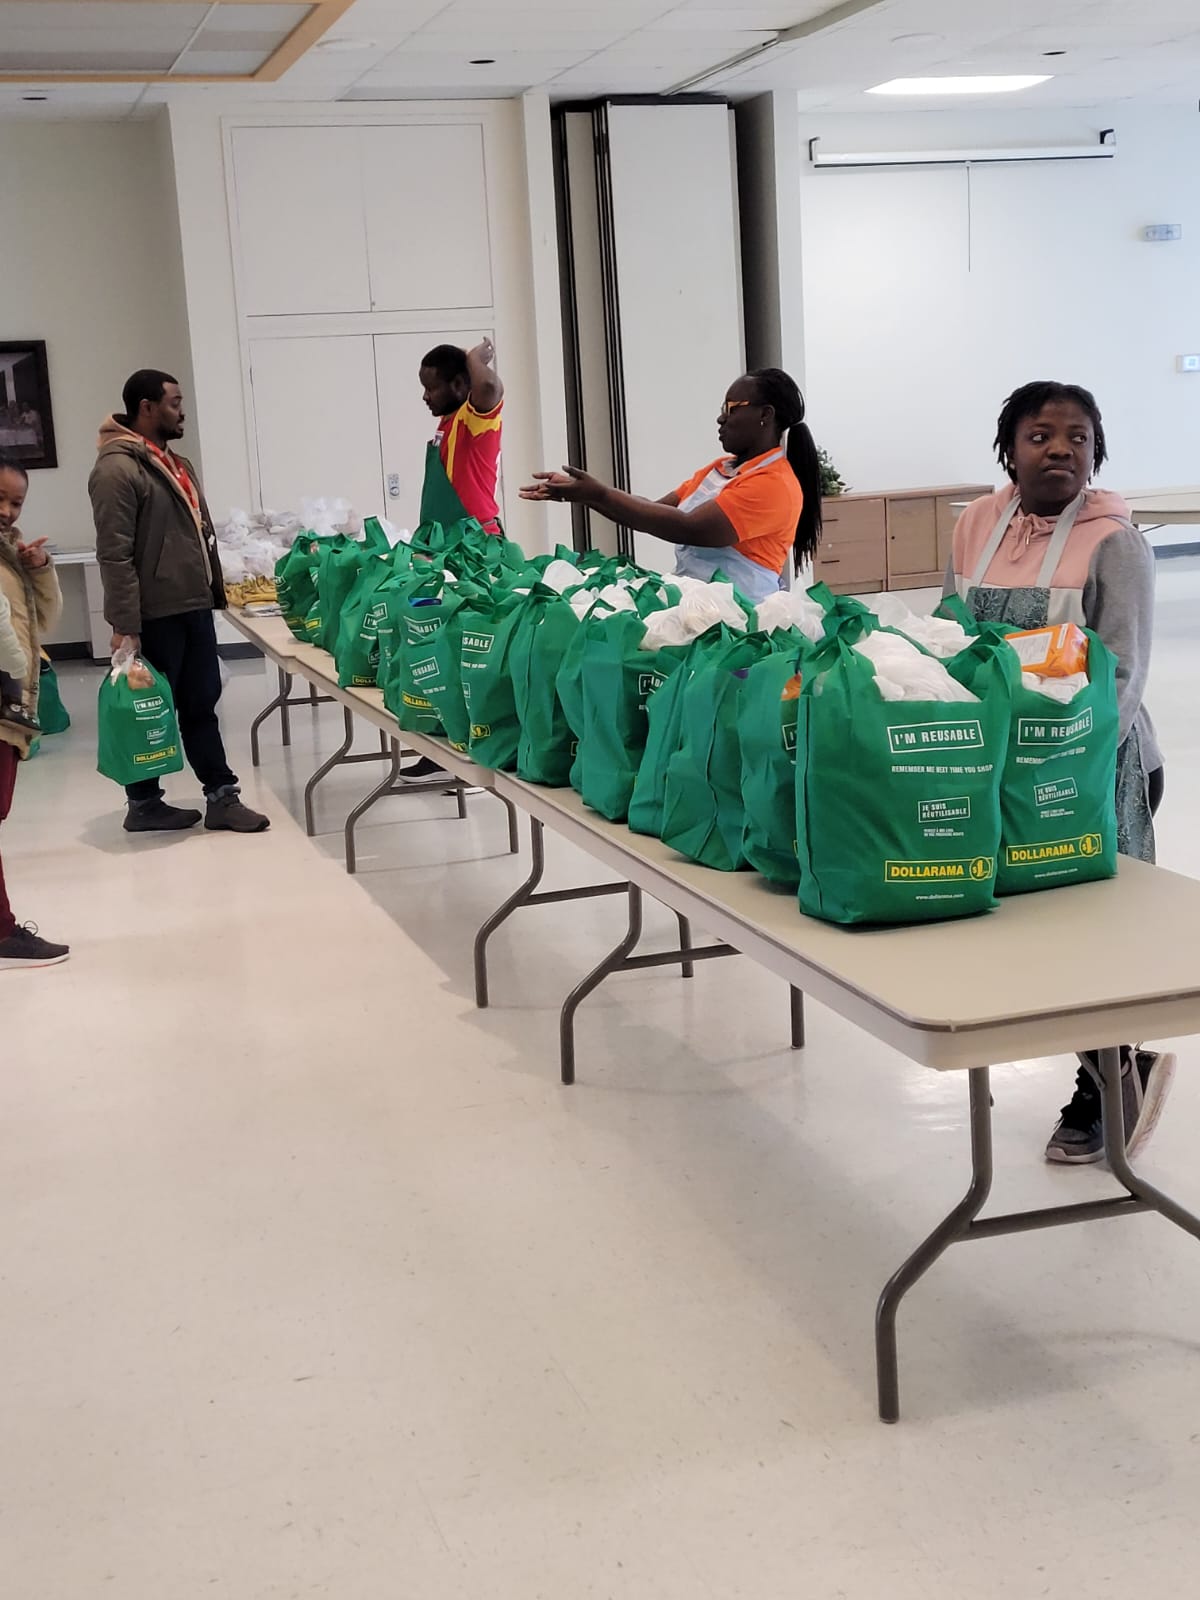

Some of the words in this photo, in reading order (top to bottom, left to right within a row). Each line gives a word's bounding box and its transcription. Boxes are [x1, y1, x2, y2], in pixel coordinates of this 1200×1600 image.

[462, 636, 490, 648] SABLE
[1024, 726, 1045, 737] I'M
[1051, 716, 1090, 737] REUSABLE
[894, 733, 917, 745] I'M
[921, 728, 977, 743] REUSABLE
[891, 765, 925, 773] REMEMBER
[936, 766, 948, 774] NEXT
[949, 766, 963, 774] TIME
[964, 766, 976, 774] YOU
[977, 764, 993, 773] SHOP
[922, 804, 929, 812] JE
[931, 802, 947, 811] SUIS
[1011, 843, 1076, 861] DOLLARAMA
[890, 865, 965, 877] DOLLARAMA
